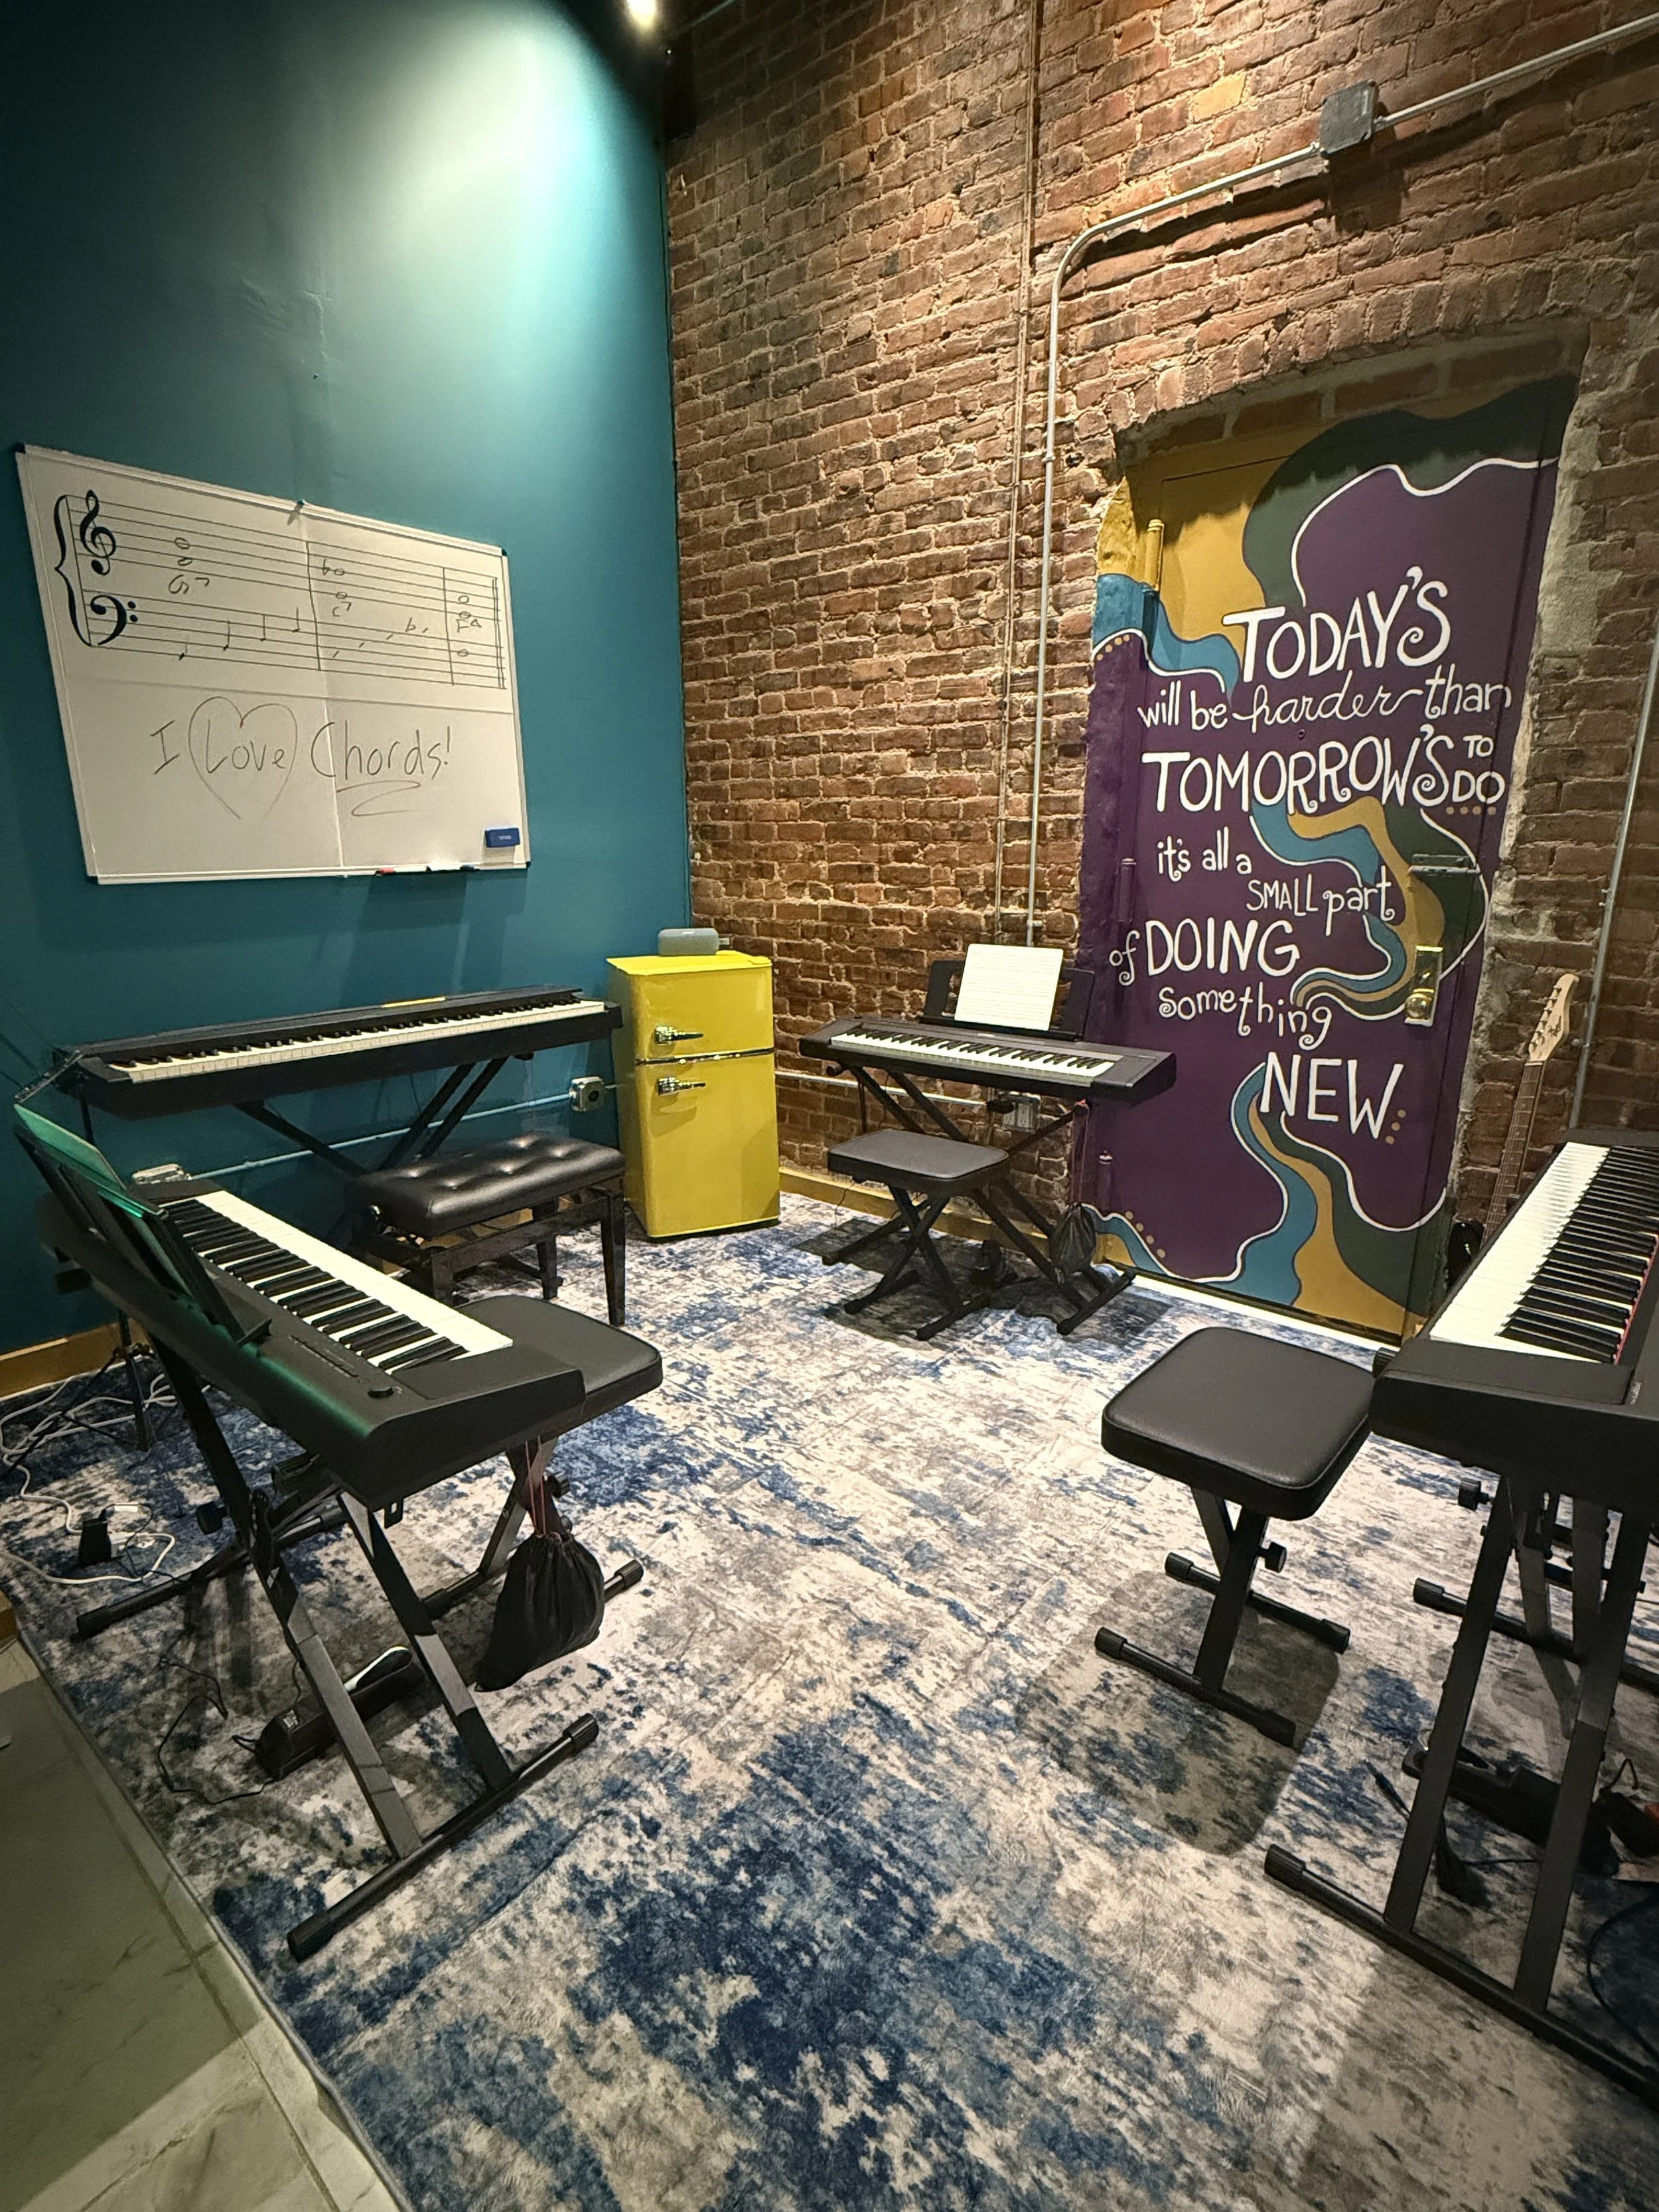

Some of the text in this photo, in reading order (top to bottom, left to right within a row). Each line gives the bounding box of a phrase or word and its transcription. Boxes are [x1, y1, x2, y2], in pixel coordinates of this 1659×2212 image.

[1222, 565, 1451, 683] TODAY'S
[1137, 663, 1512, 733] will be harder than
[151, 719, 452, 780] I Love Chords!
[1141, 723, 1506, 815] TOMORROW'S TO DO
[1157, 826, 1253, 882] it's all a
[1246, 865, 1396, 937] SMALL part
[1109, 917, 1301, 986] of DOING
[1260, 1051, 1404, 1140] NEW
